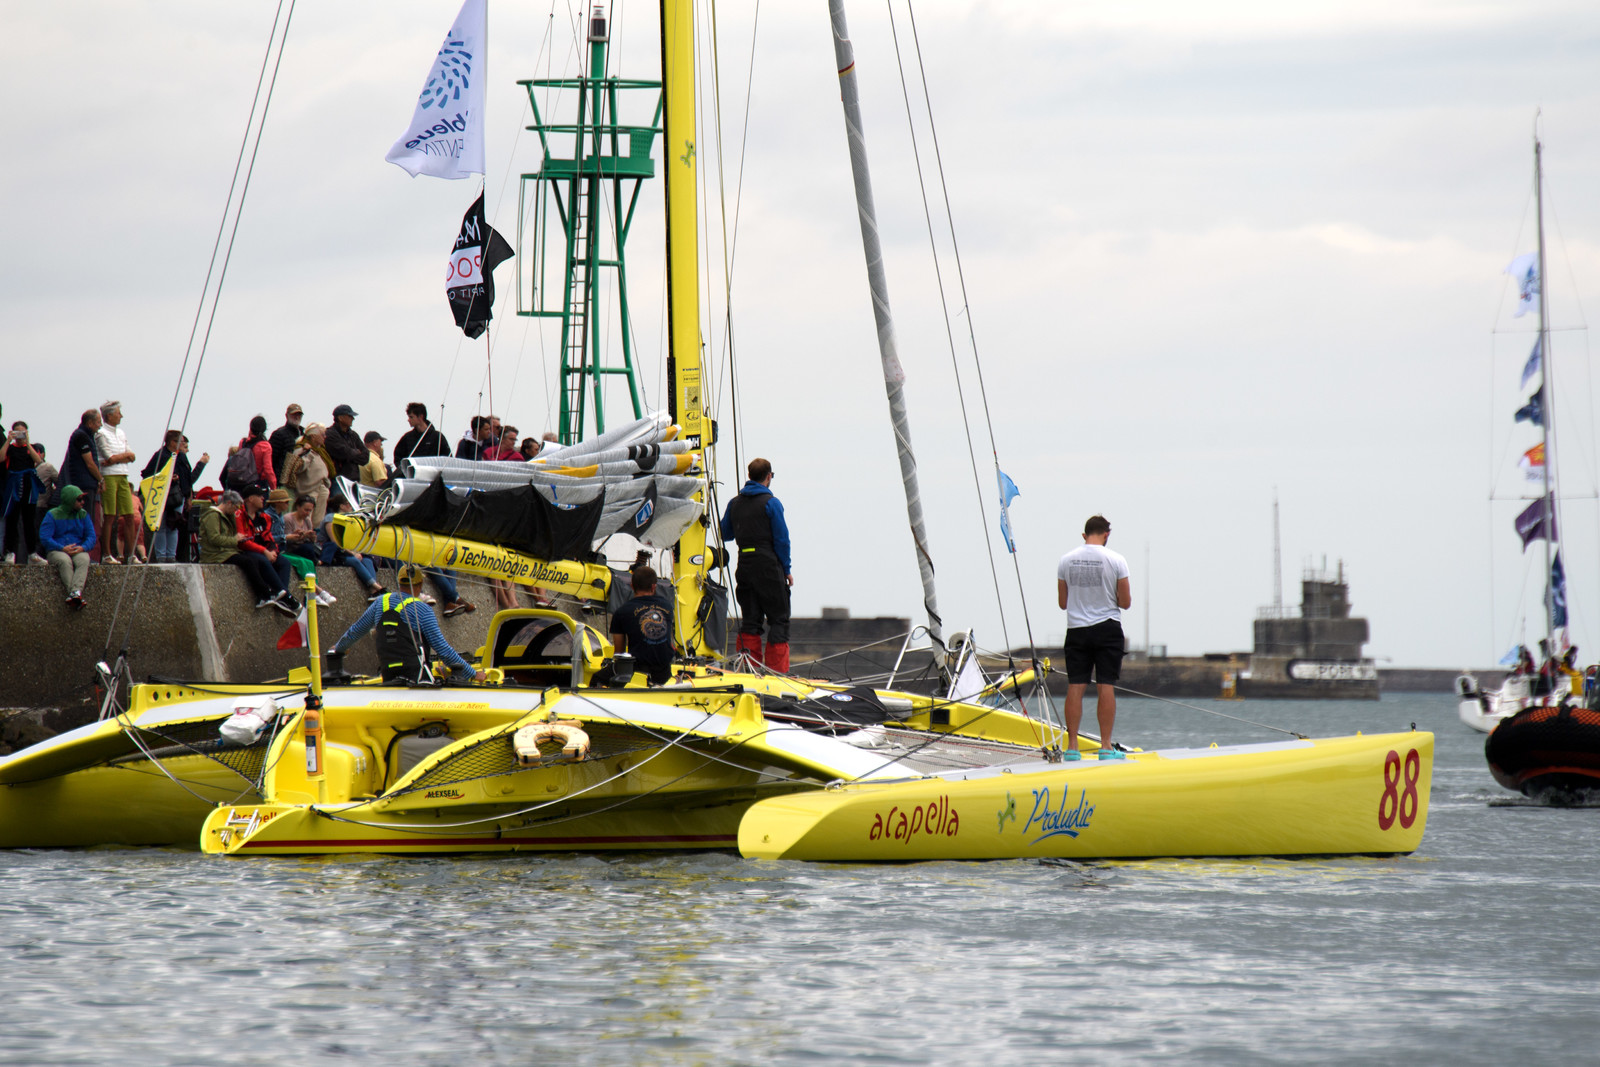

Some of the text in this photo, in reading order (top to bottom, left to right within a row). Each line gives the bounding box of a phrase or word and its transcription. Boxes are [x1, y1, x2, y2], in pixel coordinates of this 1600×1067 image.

[459, 546, 570, 586] Technologie Marine
[427, 789, 460, 799] ALEXSEAL
[1378, 747, 1420, 831] 88
[869, 794, 960, 845] acapella
